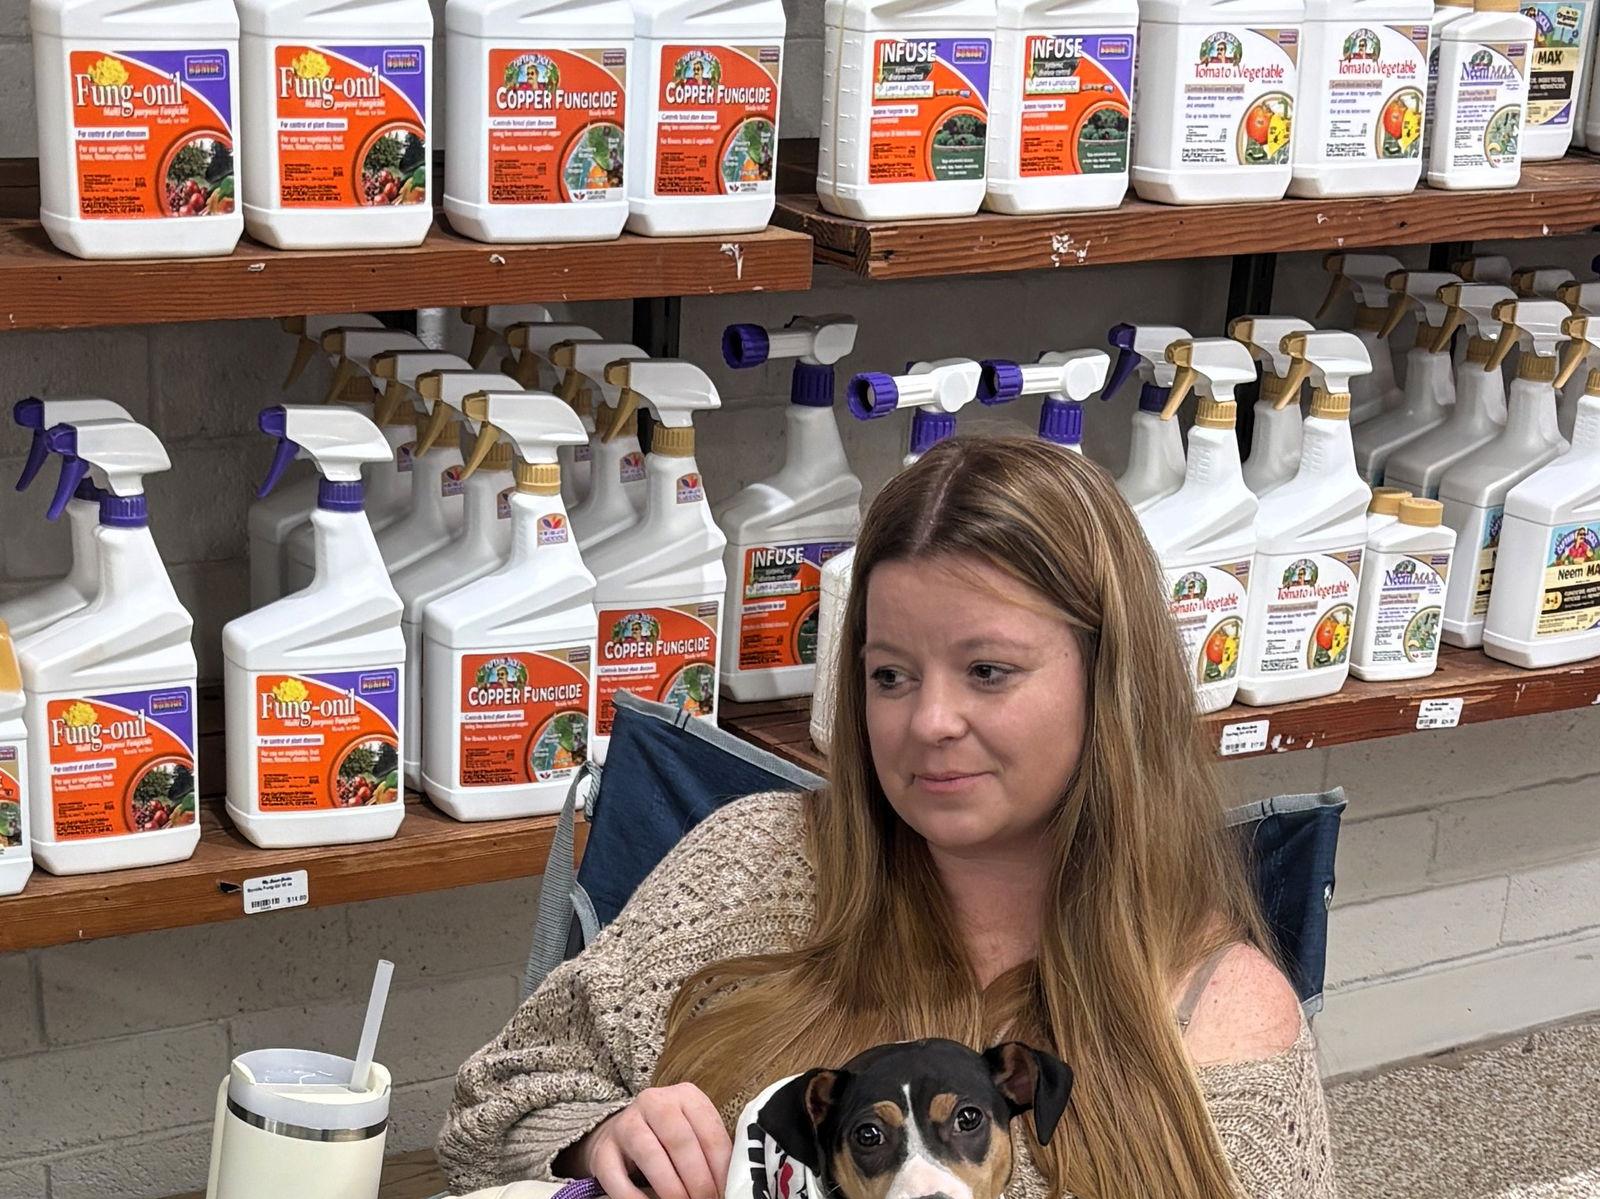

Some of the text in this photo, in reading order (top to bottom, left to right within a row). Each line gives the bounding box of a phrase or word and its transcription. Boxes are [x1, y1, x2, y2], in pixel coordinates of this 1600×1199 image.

[881, 41, 937, 63] INFUSE
[1031, 37, 1083, 58] INFUSE
[1537, 50, 1563, 65] MAX
[1194, 63, 1231, 79] Tomato
[1237, 63, 1285, 83] Vegetable
[1338, 60, 1370, 75] Tomato
[1376, 60, 1417, 79] Vegetable
[1460, 62, 1516, 81] Neem MAX
[76, 72, 183, 117] Fung-onil
[279, 65, 380, 110] Fung-onil
[496, 87, 618, 109] COPPER FUNGICIDE
[666, 82, 771, 104] COPPER FUNGICIDE
[751, 547, 805, 568] INFUSE
[1414, 571, 1439, 586] MAX
[1558, 564, 1600, 581] Neem MA
[1277, 586, 1309, 601] Tomato
[1314, 581, 1349, 600] Vegetable
[1203, 593, 1239, 613] Vegetable
[604, 636, 710, 659] COPPER FUNGICIDE
[468, 683, 583, 706] COPPER FUNGICIDE
[261, 689, 356, 728] Fung-onil
[51, 709, 147, 752] Fung-onil
